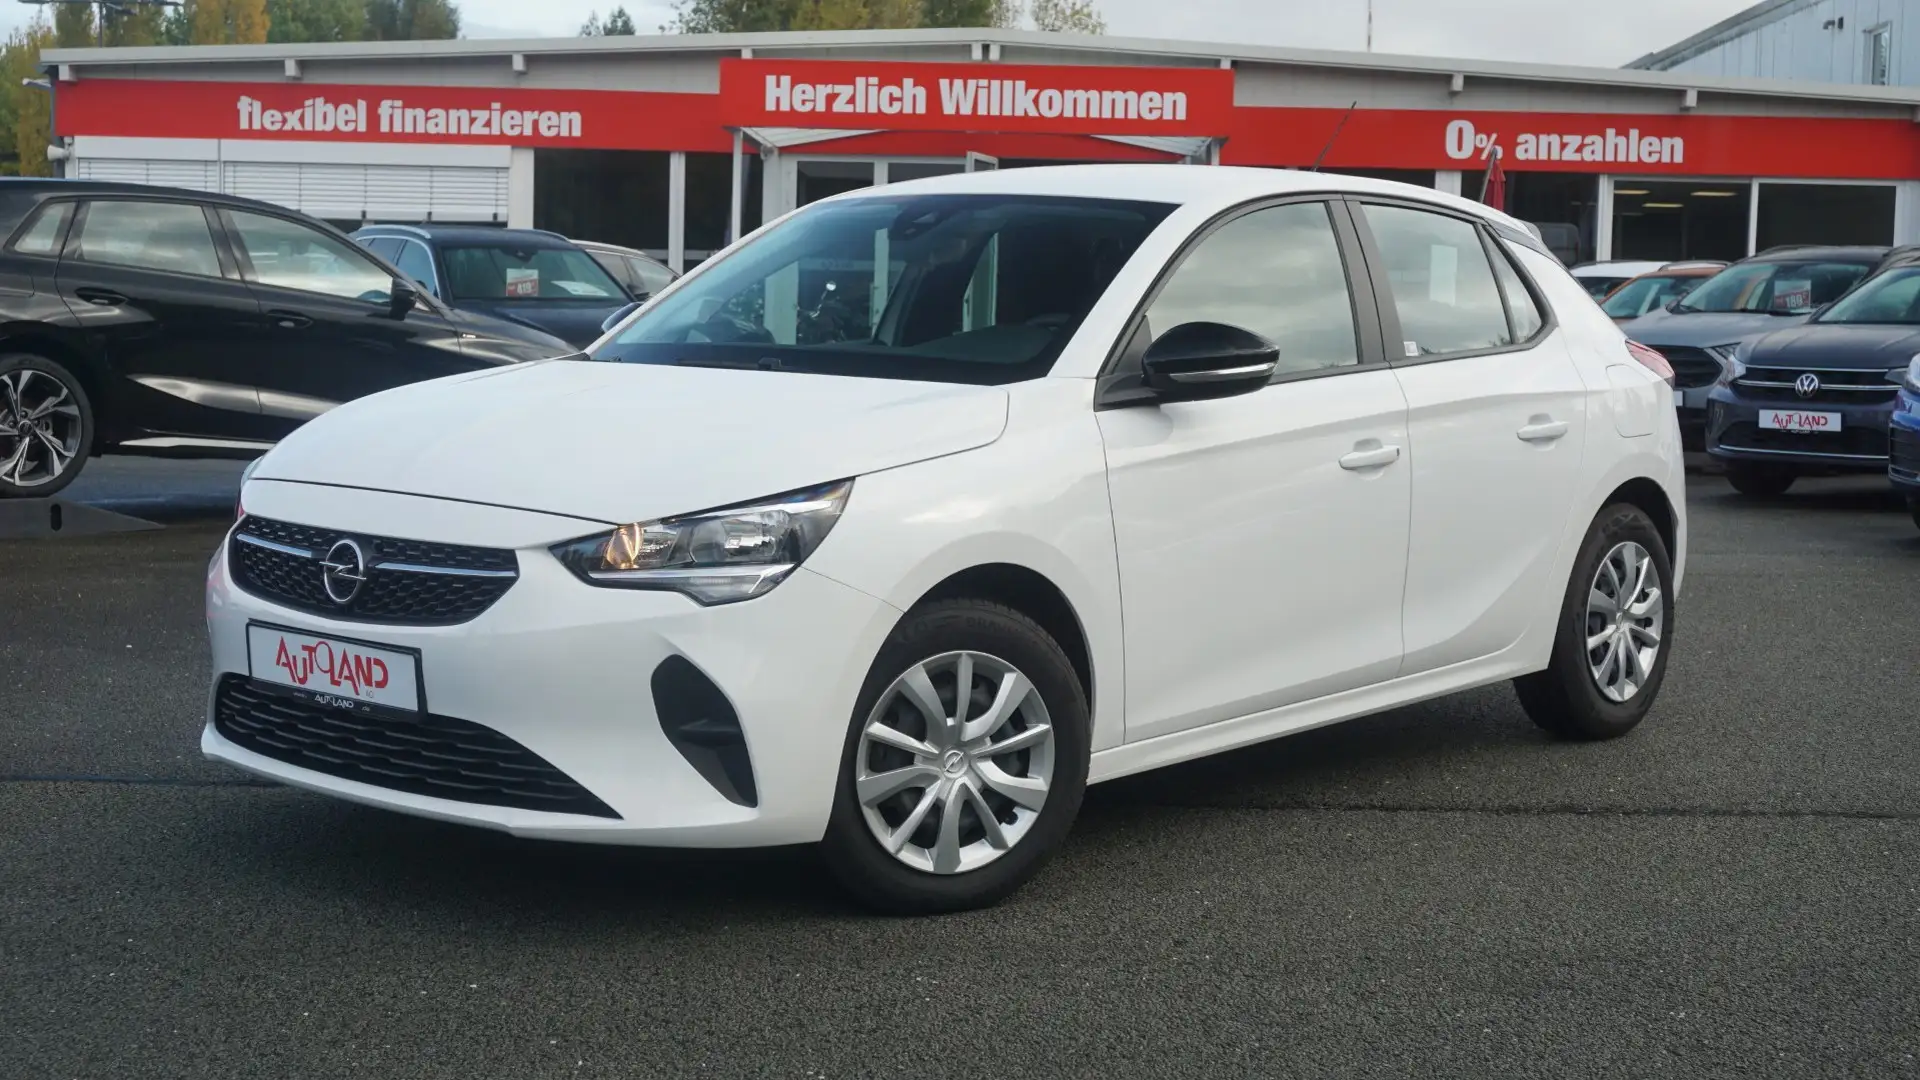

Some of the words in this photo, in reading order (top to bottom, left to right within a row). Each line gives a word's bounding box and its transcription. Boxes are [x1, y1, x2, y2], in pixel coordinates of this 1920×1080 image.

[237, 95, 367, 132] flexibel
[377, 99, 582, 137] finanzieren
[765, 75, 926, 115] Herzlich
[939, 79, 1187, 120] Willkommen
[1515, 128, 1684, 163] anzahlen
[1772, 412, 1828, 429] AUTOLAND
[275, 636, 389, 696] AUTOLAND
